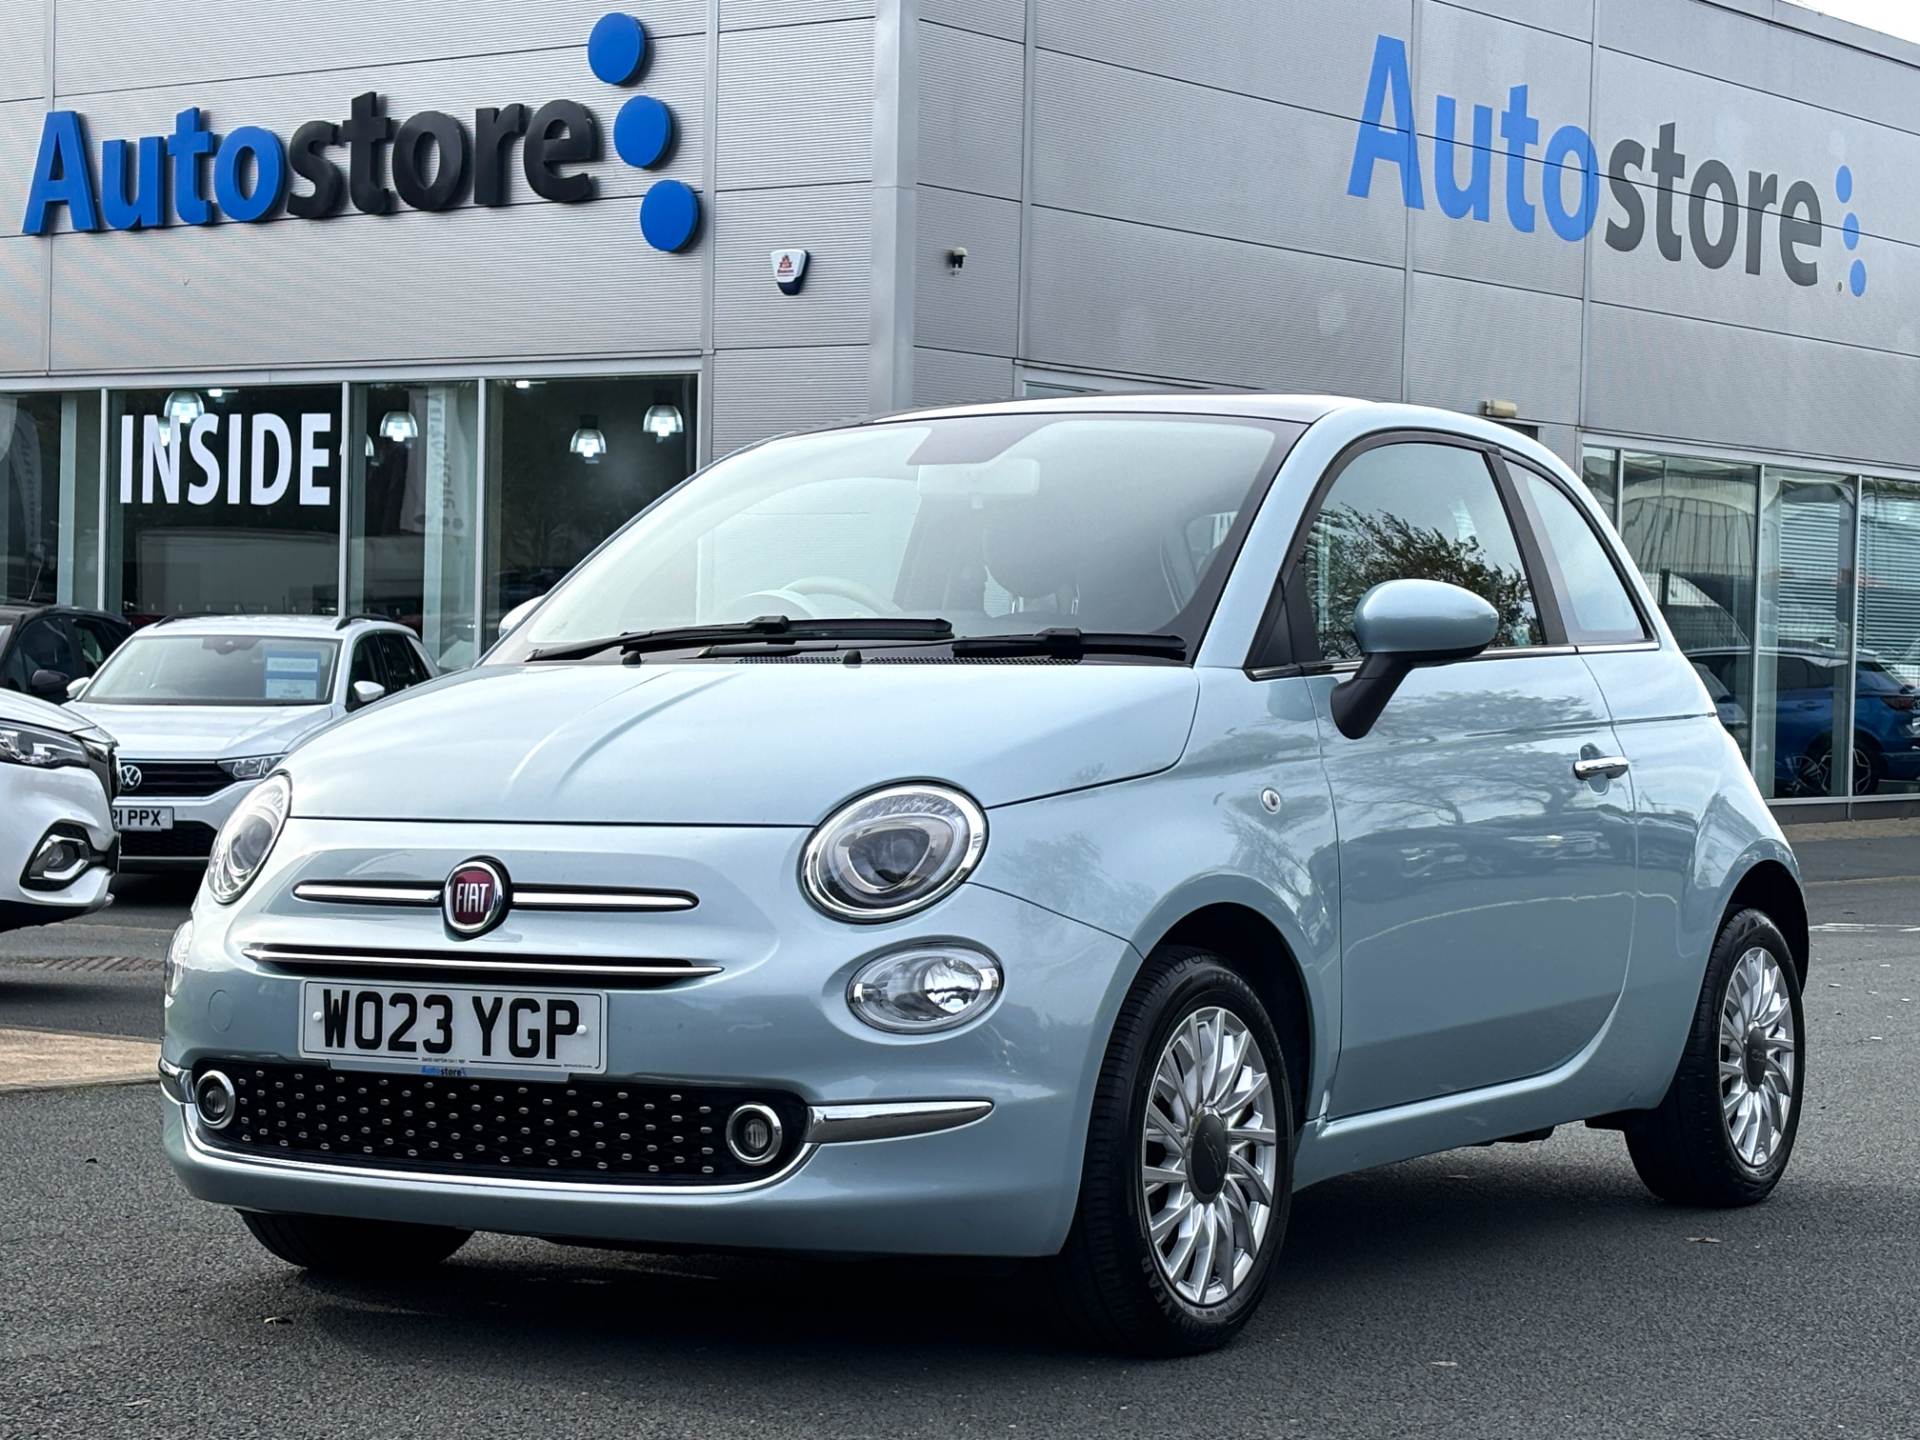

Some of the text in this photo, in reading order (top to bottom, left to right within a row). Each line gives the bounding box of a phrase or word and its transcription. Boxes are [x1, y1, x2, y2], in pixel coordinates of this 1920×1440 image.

[22, 91, 600, 235] Autostore
[1347, 34, 1823, 287] Autostore
[120, 412, 331, 506] INSIDE
[128, 810, 161, 827] PPX
[456, 883, 489, 913] FIAT
[323, 989, 580, 1060] WO23 YGP
